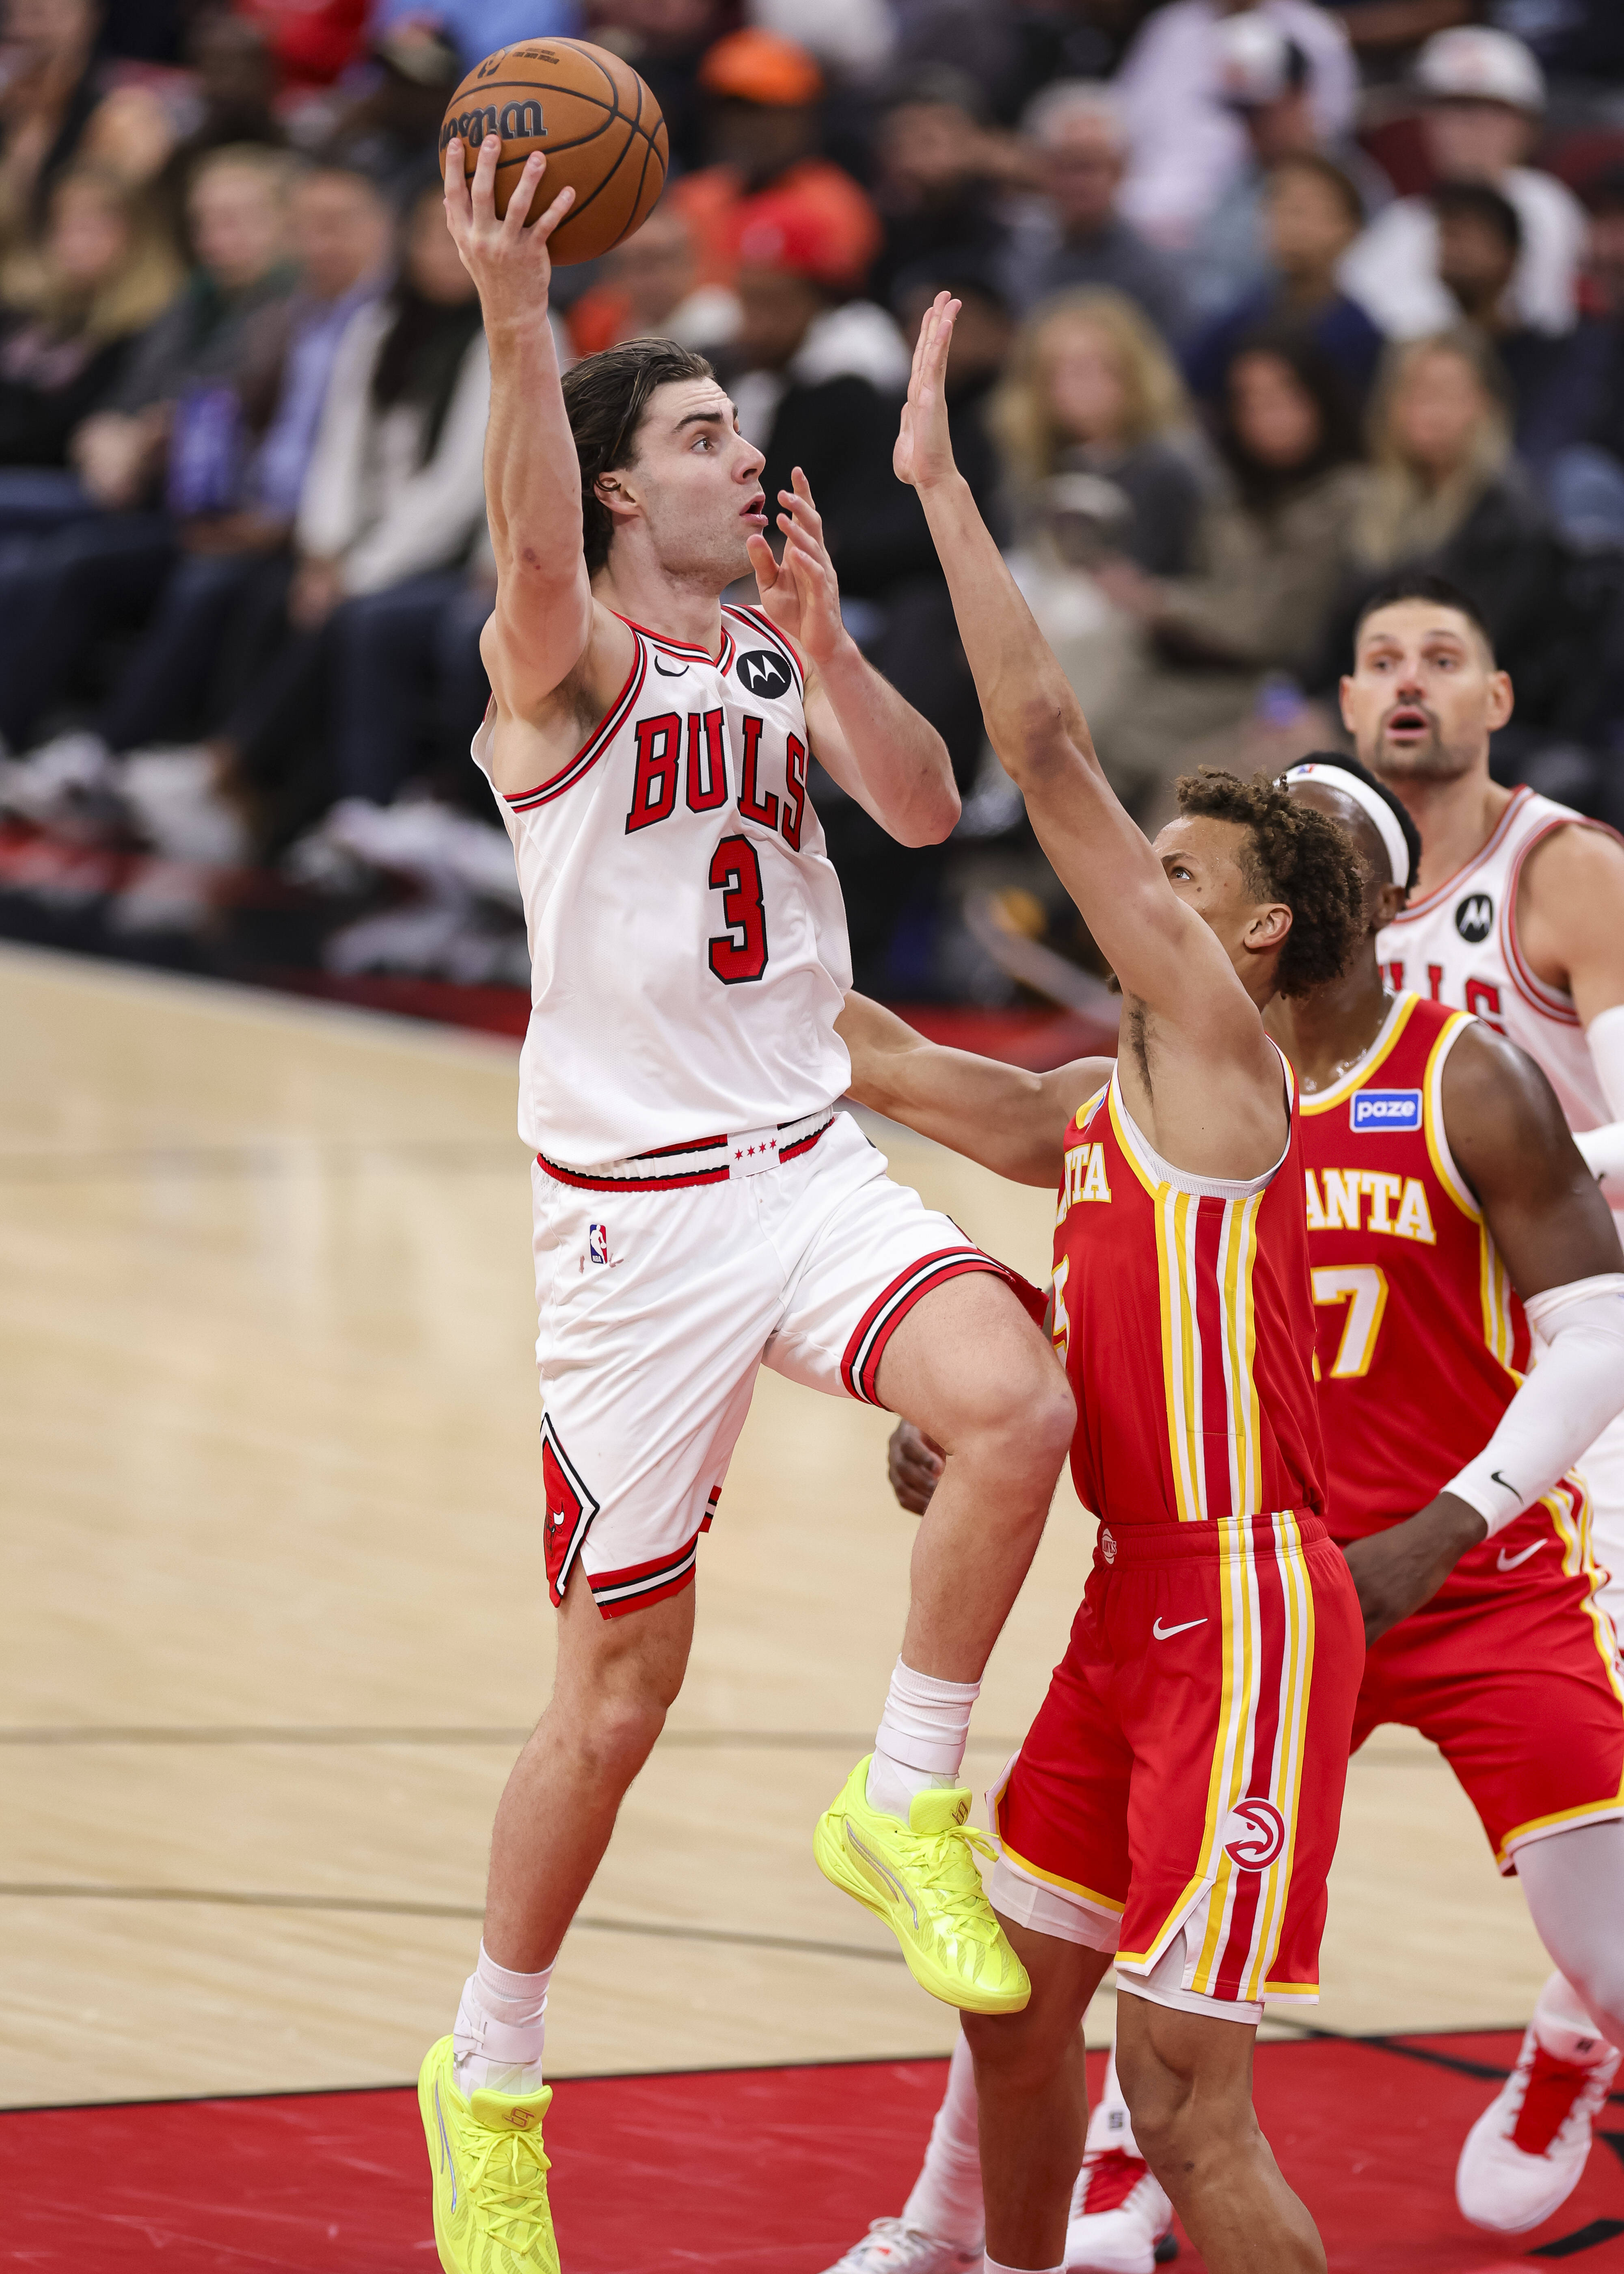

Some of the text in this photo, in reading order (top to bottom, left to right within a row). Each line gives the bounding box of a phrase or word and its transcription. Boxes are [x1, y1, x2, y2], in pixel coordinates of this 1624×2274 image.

[625, 707, 806, 853] BULS
[708, 834, 769, 985] 3
[1357, 1100, 1416, 1122] paze
[1311, 1263, 1389, 1382] 7
